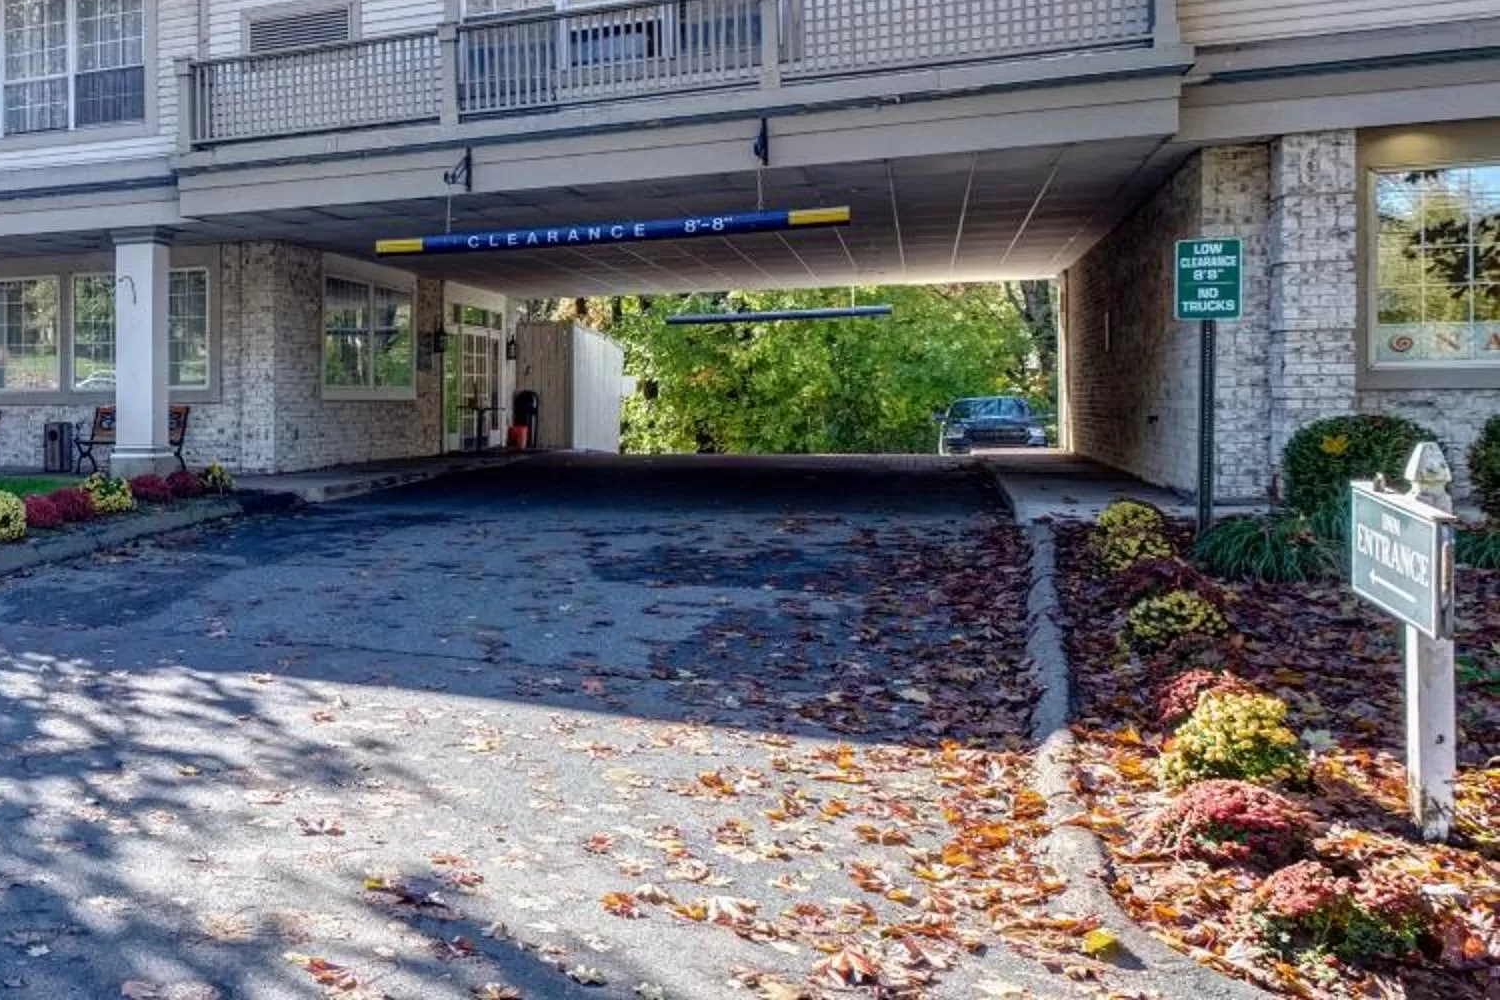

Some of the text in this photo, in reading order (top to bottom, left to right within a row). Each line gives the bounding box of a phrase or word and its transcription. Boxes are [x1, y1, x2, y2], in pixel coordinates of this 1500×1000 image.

[467, 223, 646, 249] CLEARANCE
[1193, 243, 1223, 255] LOW
[1180, 255, 1237, 268] CLEARANCE
[1197, 287, 1219, 299] NO
[1182, 300, 1235, 312] TRUCKS
[1357, 523, 1430, 588] ENTRANCE
